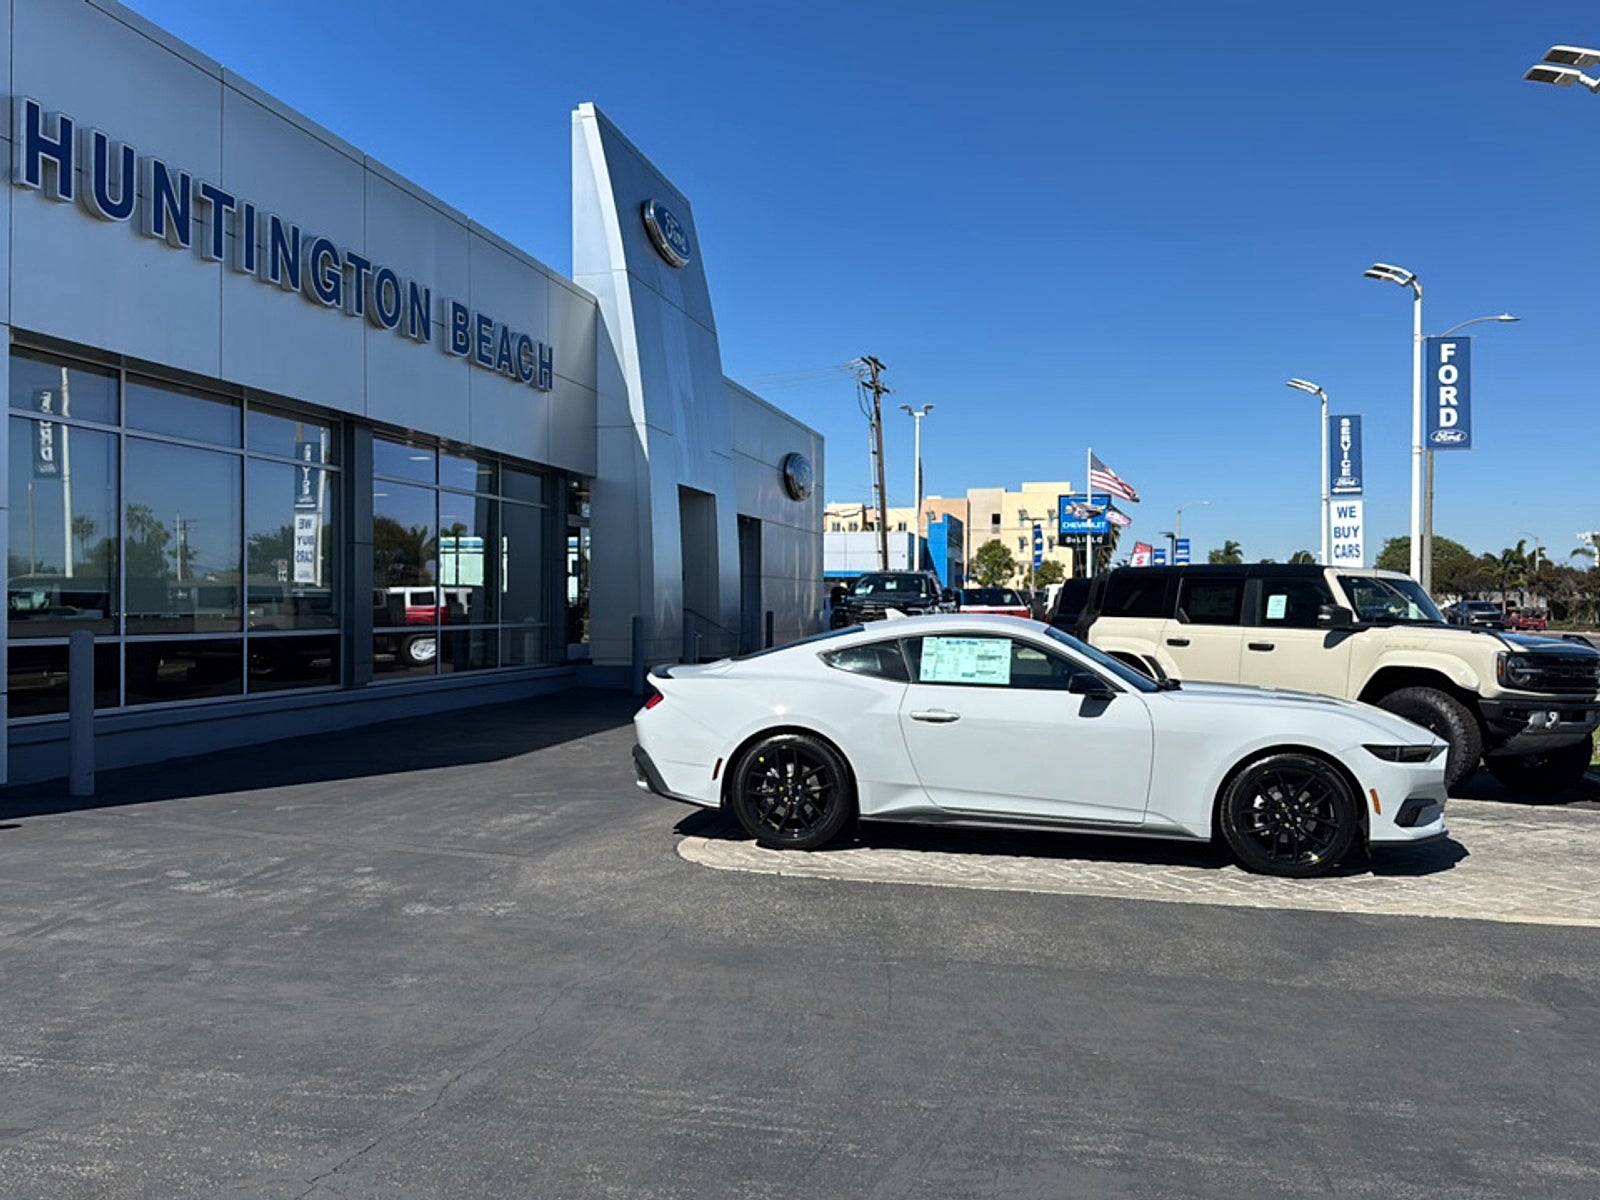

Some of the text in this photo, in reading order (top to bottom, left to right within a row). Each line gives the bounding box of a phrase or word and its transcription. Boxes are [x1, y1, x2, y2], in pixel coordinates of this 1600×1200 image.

[664, 211, 687, 253] Ford
[20, 97, 554, 391] HUNTINGTON BEACH
[1438, 343, 1458, 428] FORD
[1434, 430, 1462, 443] Ford
[1340, 418, 1351, 476] SERVICE
[1336, 505, 1356, 519] WE
[1062, 521, 1106, 529] CHEVRLET
[1333, 525, 1360, 539] BUY
[1333, 543, 1361, 559] CARS
